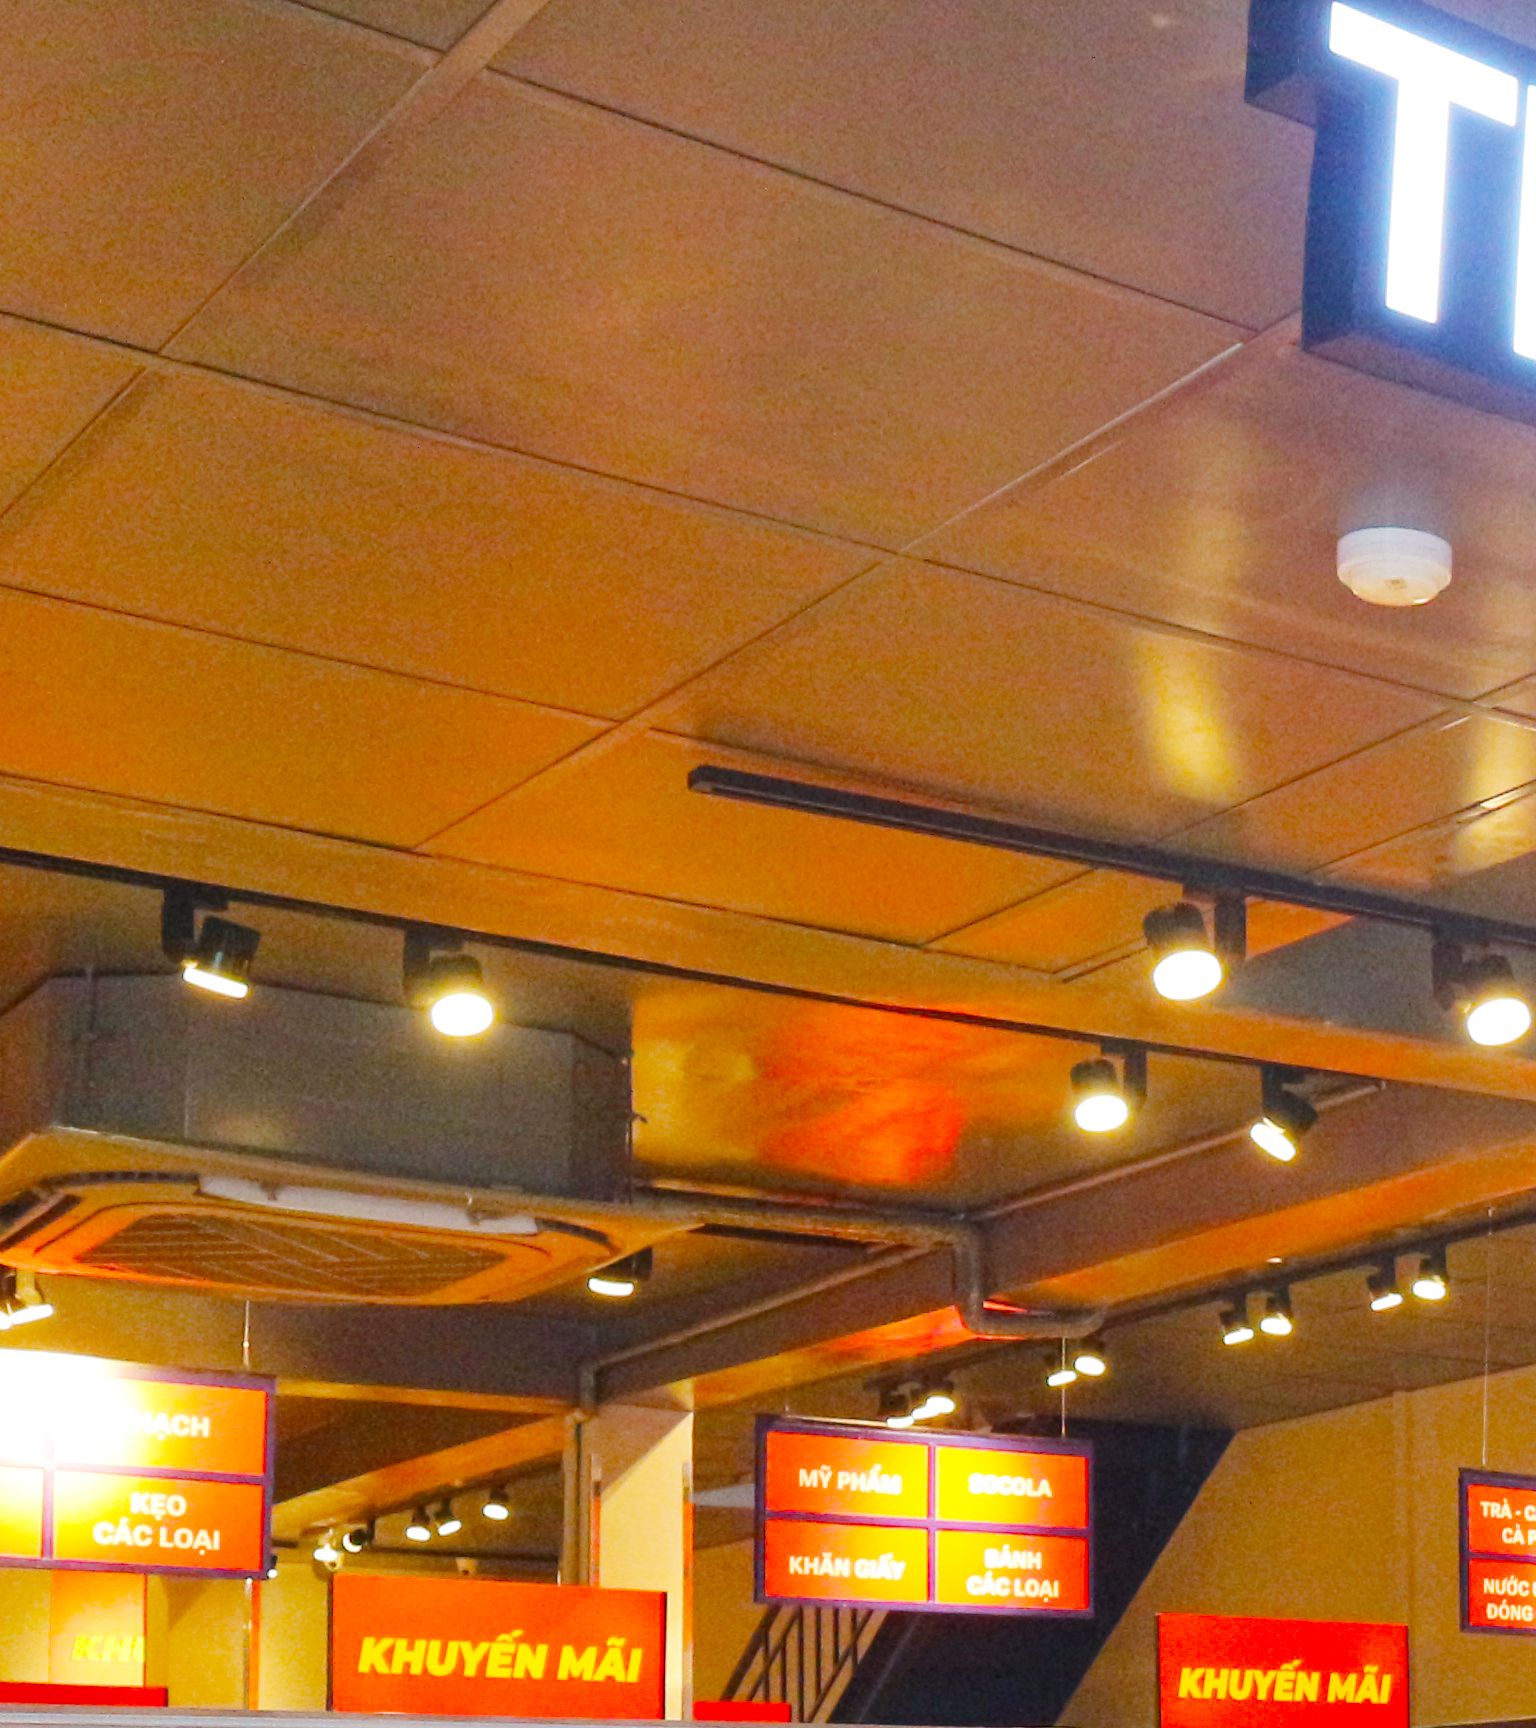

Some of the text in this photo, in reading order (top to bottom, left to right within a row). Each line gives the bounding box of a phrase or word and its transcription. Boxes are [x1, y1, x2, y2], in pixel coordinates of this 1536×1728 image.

[799, 1464, 832, 1489] MỸ
[967, 1472, 1053, 1499] SOCOLA
[130, 1491, 187, 1521] KẸO
[1480, 1498, 1512, 1520] TRÀ
[93, 1516, 221, 1556] CÁC LOẠI
[1502, 1523, 1525, 1546] CÀ
[789, 1552, 851, 1577] KHĂN
[983, 1543, 1042, 1570] BÁNH
[966, 1570, 1060, 1603] CÁC LOẠI
[1483, 1574, 1530, 1597] NƯỚC
[1486, 1598, 1533, 1622] ĐÓNG
[357, 1628, 644, 1683] KHUYẾN MÃI
[1177, 1658, 1392, 1706] KHUYẾN MÃI
